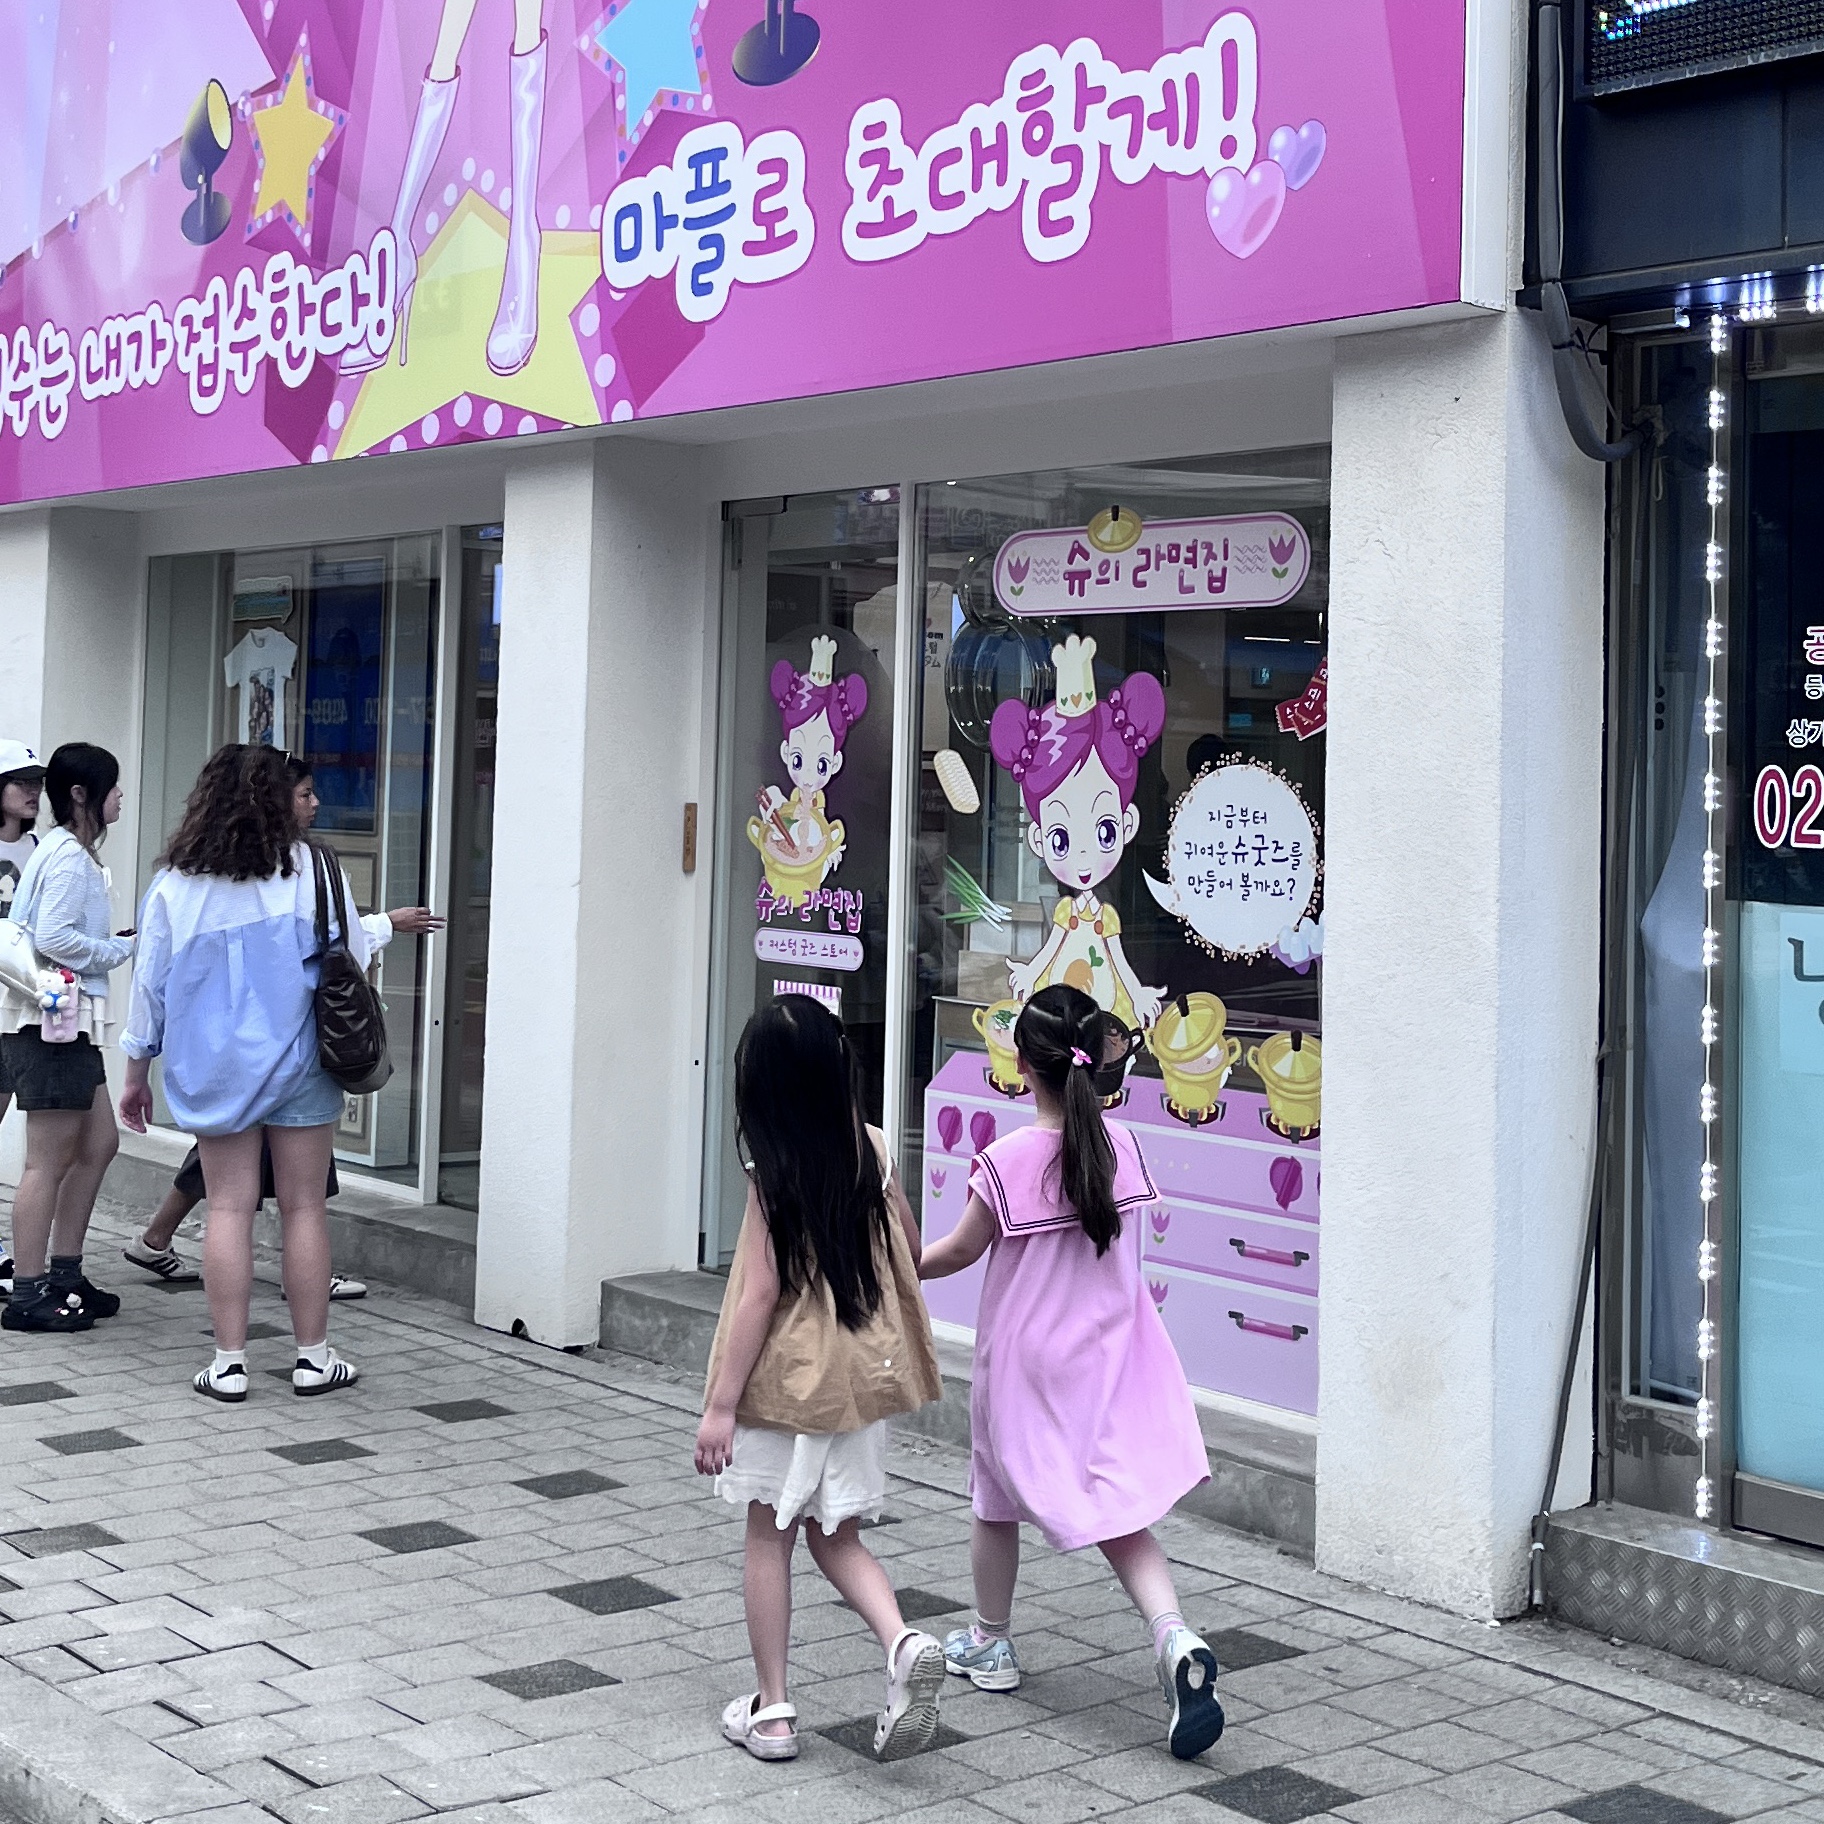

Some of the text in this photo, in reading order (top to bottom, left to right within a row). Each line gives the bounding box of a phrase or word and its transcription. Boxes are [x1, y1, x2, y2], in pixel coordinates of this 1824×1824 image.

[608, 24, 1248, 309] 마플로 초대할게!
[0, 238, 391, 433] 수는 내가 접수한다!
[1063, 537, 1230, 598] 슈의 라면집
[1208, 804, 1268, 829] 지금부터
[1184, 841, 1229, 866] 귀여운
[756, 876, 862, 933] 슈의 라면집
[1187, 870, 1296, 900] 만들어 볼까요?
[820, 943, 848, 958] 스토어
